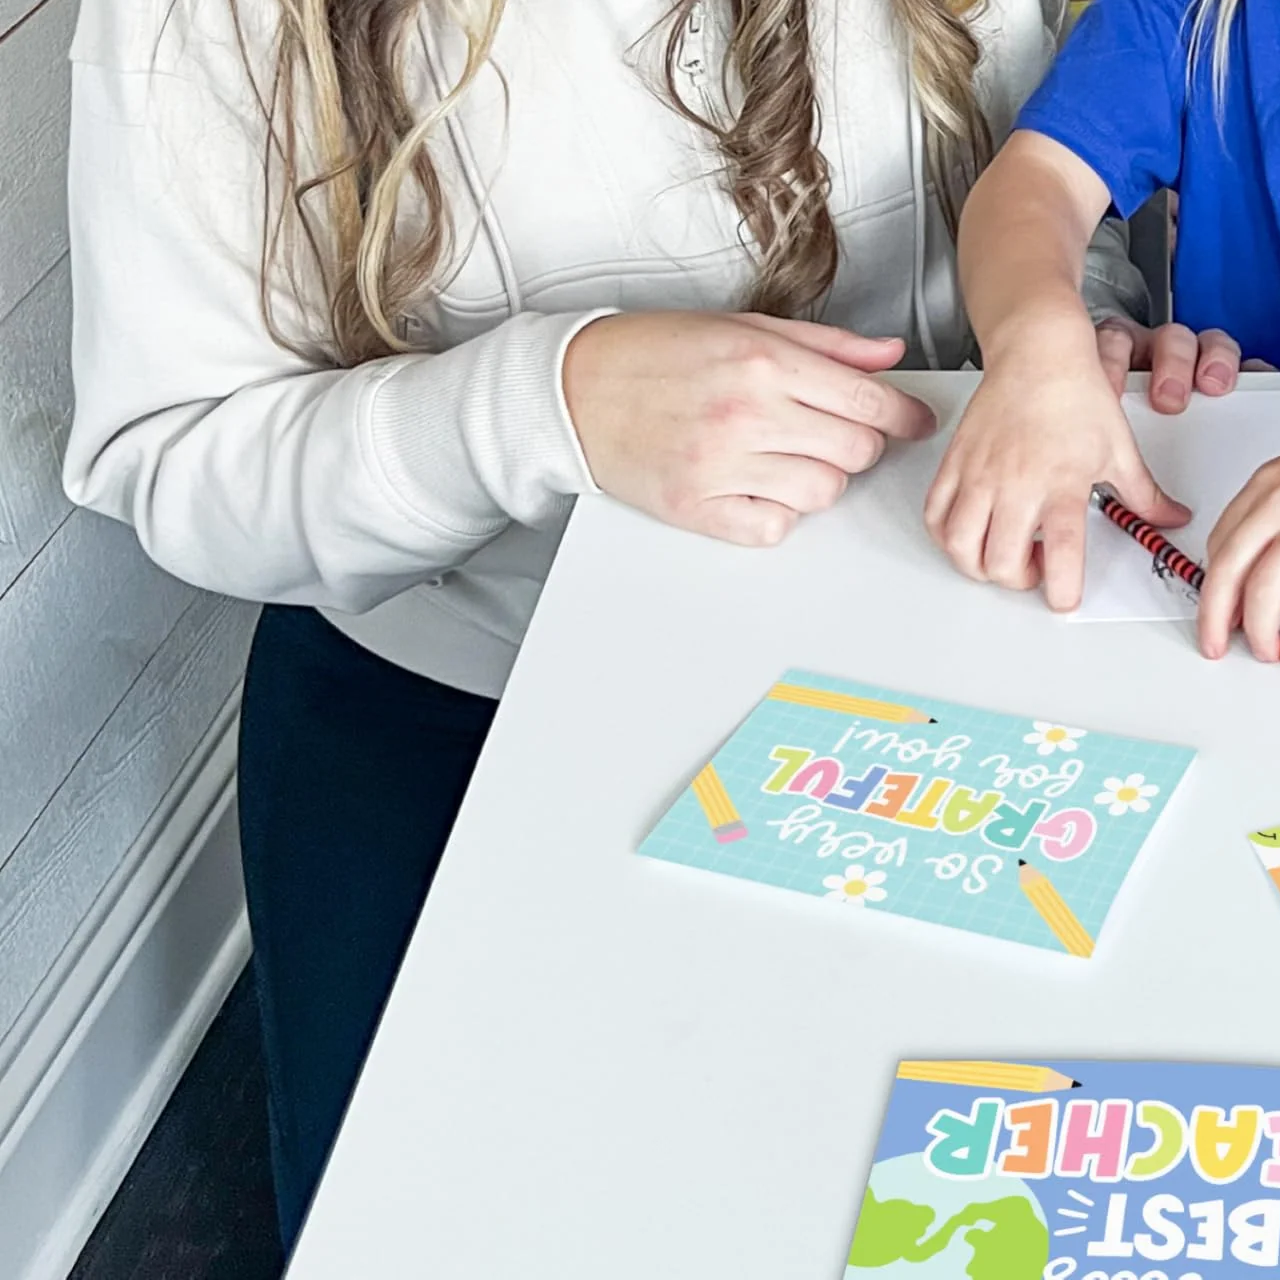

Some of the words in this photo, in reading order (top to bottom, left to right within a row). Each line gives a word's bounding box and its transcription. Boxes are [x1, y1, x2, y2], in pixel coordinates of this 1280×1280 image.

[832, 720, 972, 772] you!
[979, 752, 1085, 799] for
[762, 746, 1097, 862] GRATEFUL
[766, 804, 908, 868] very
[924, 854, 1004, 895] So
